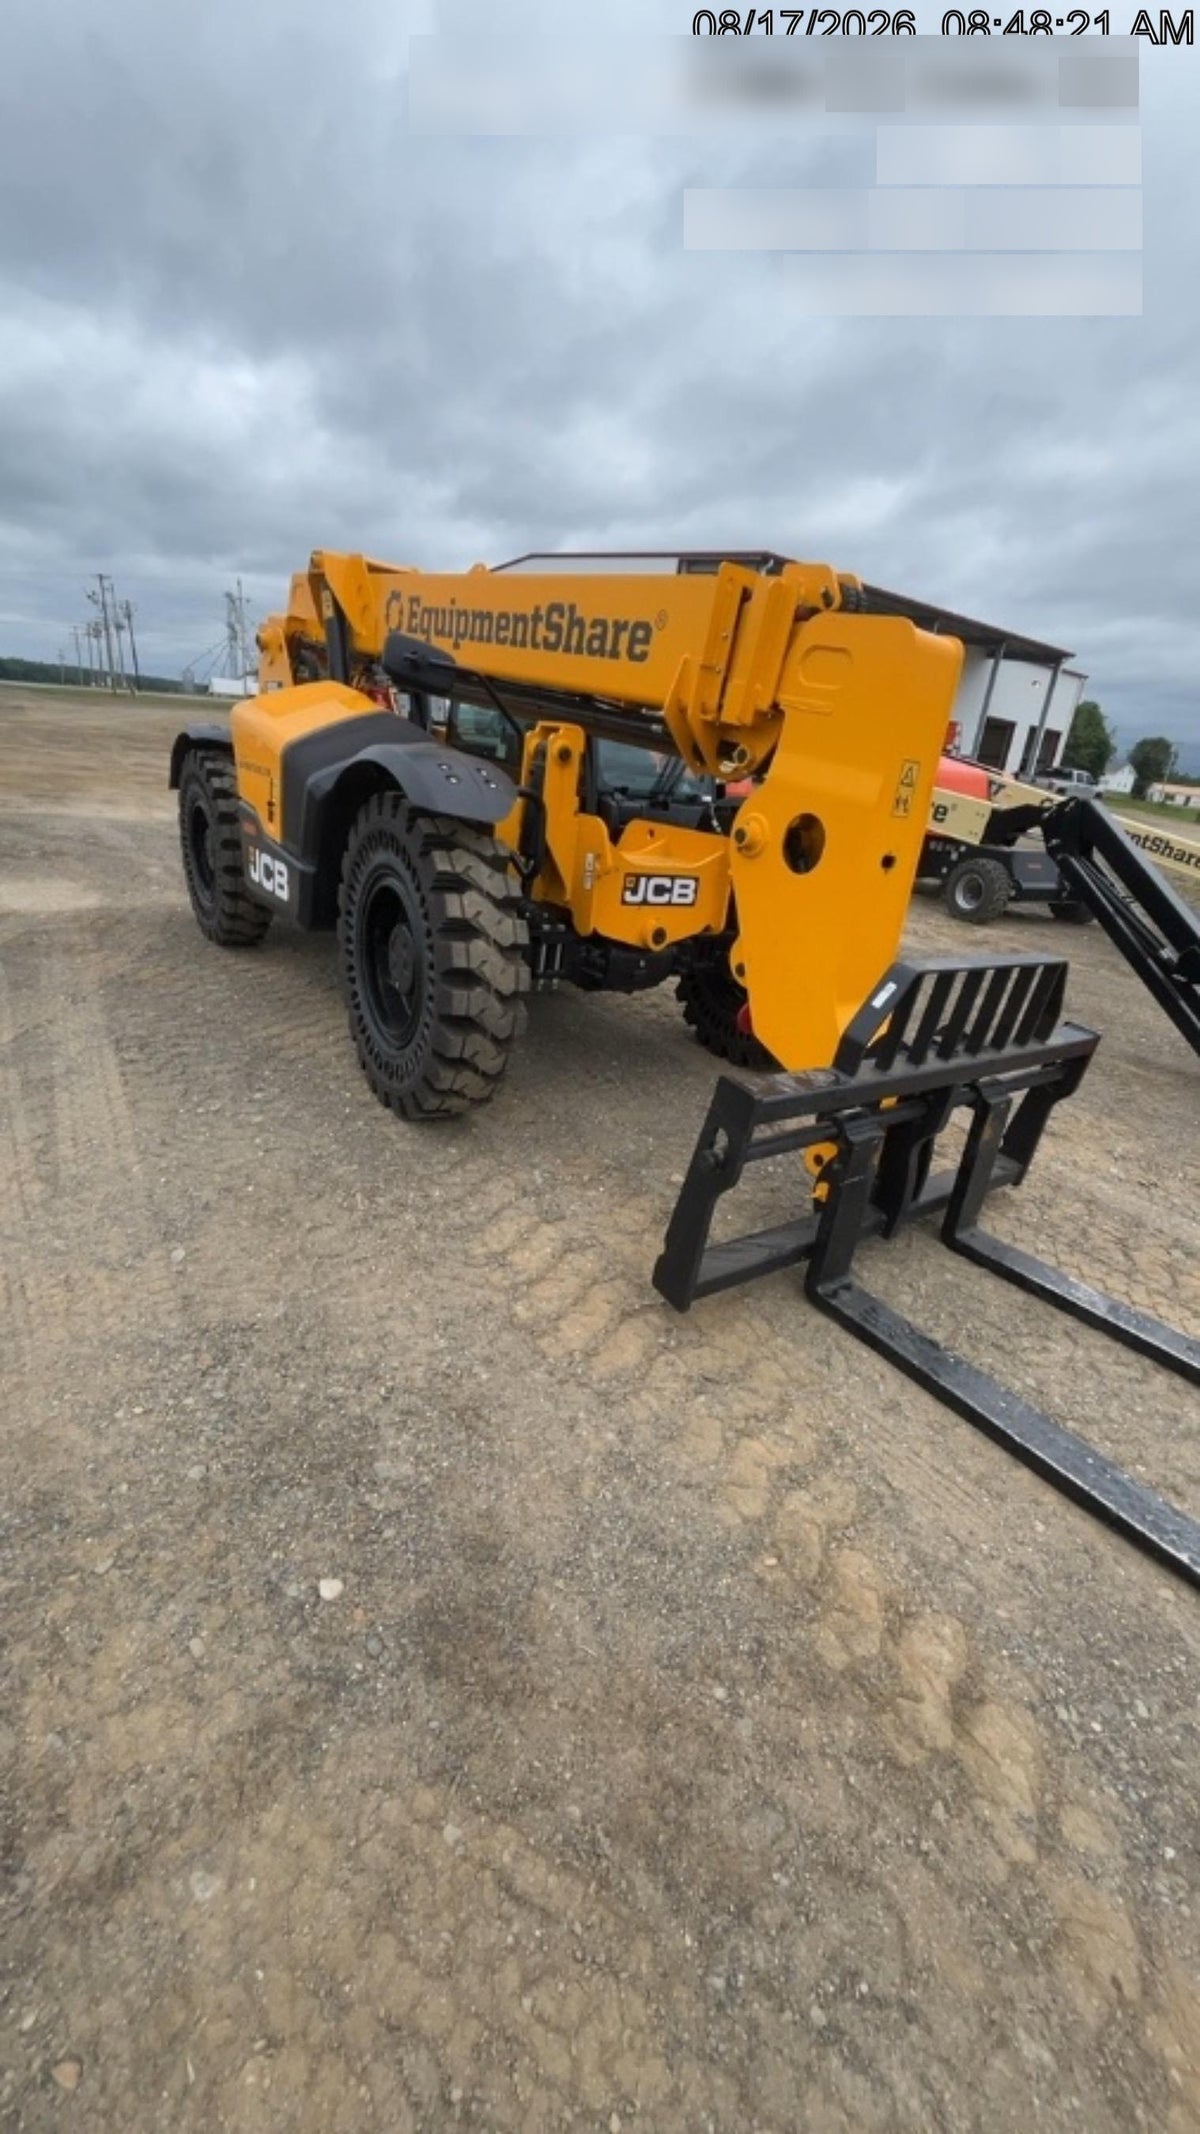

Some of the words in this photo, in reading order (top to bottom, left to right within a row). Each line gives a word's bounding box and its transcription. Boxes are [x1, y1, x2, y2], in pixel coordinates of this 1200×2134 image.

[408, 595, 653, 663] EquipmentShare
[249, 846, 289, 901] JCB
[624, 876, 696, 905] JCB
